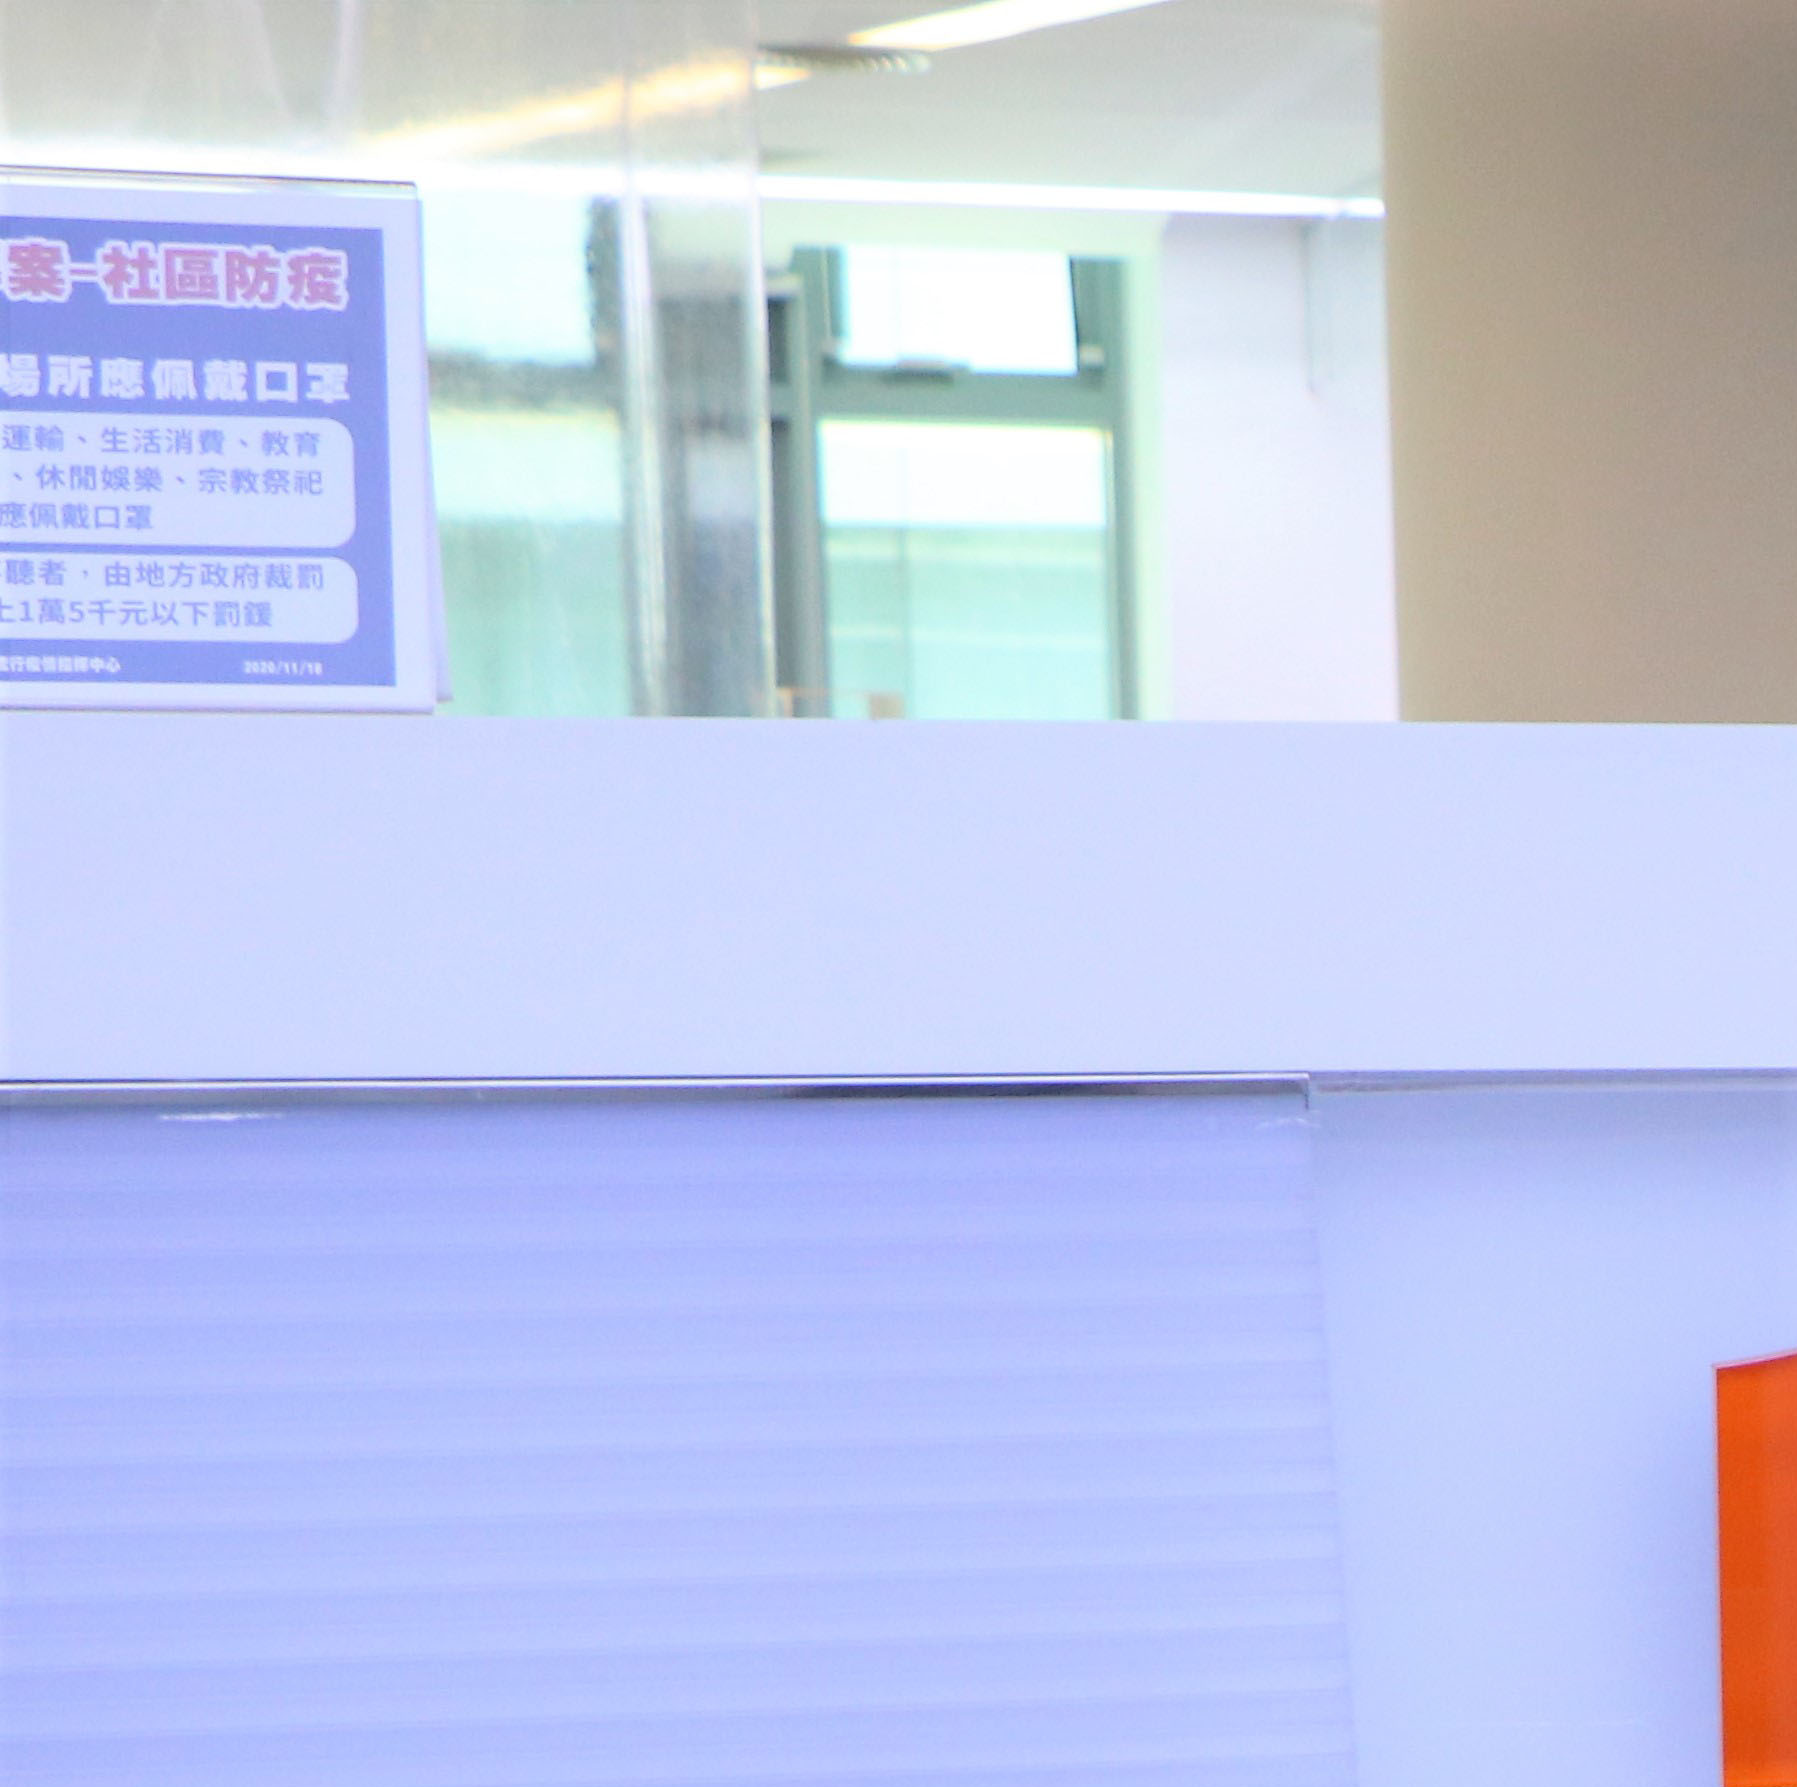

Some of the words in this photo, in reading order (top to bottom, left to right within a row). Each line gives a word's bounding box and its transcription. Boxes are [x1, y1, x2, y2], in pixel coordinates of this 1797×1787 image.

[0, 353, 350, 404] 場所應佩戴口罩
